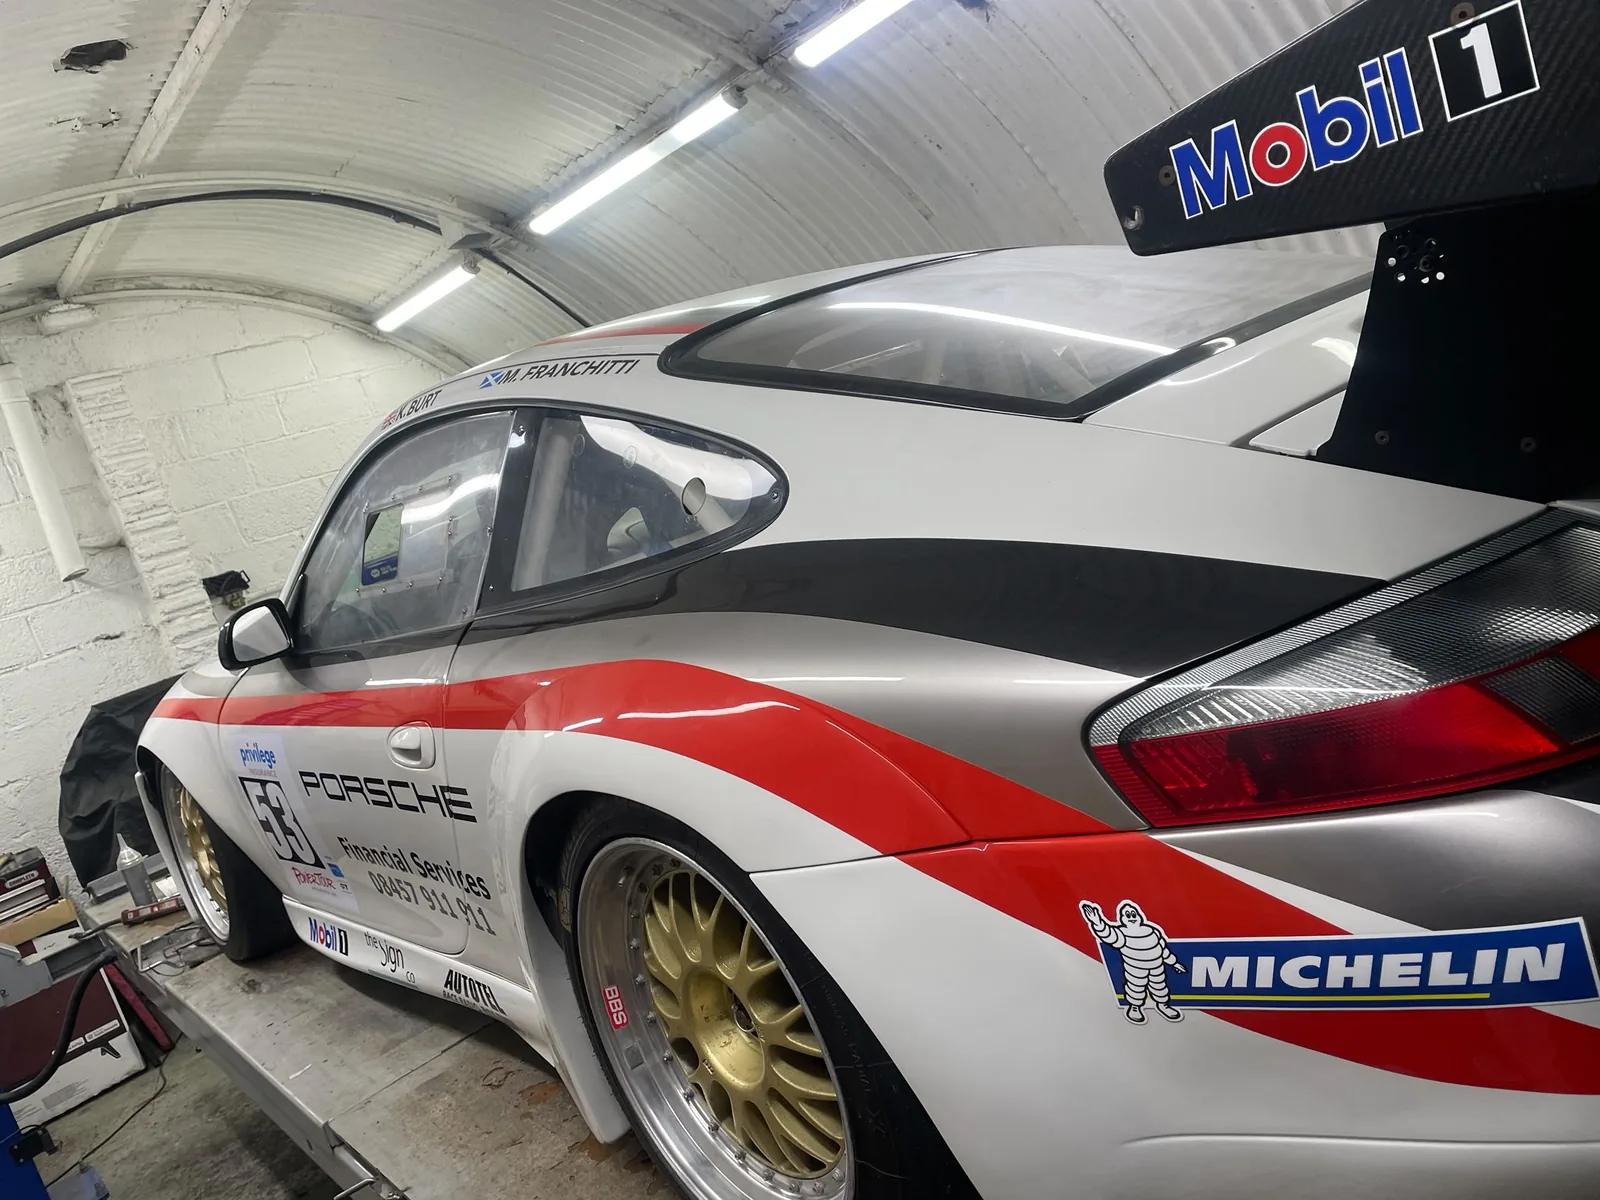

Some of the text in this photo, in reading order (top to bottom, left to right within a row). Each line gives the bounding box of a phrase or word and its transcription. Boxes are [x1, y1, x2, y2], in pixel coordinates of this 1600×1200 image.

[1169, 22, 1503, 219] Mobil 1
[500, 359, 641, 385] M. FRANCHITTI
[239, 742, 276, 769] privilege
[298, 771, 478, 823] PORSCHE
[244, 780, 316, 865] 53
[337, 836, 491, 900] Financial Services
[367, 871, 497, 936] 08457 911 911
[308, 917, 337, 952] Mobil
[364, 931, 379, 949] the
[1191, 942, 1566, 989] MICHELIN
[444, 969, 507, 1016] AUTOTEL
[604, 985, 628, 1025] BBS
